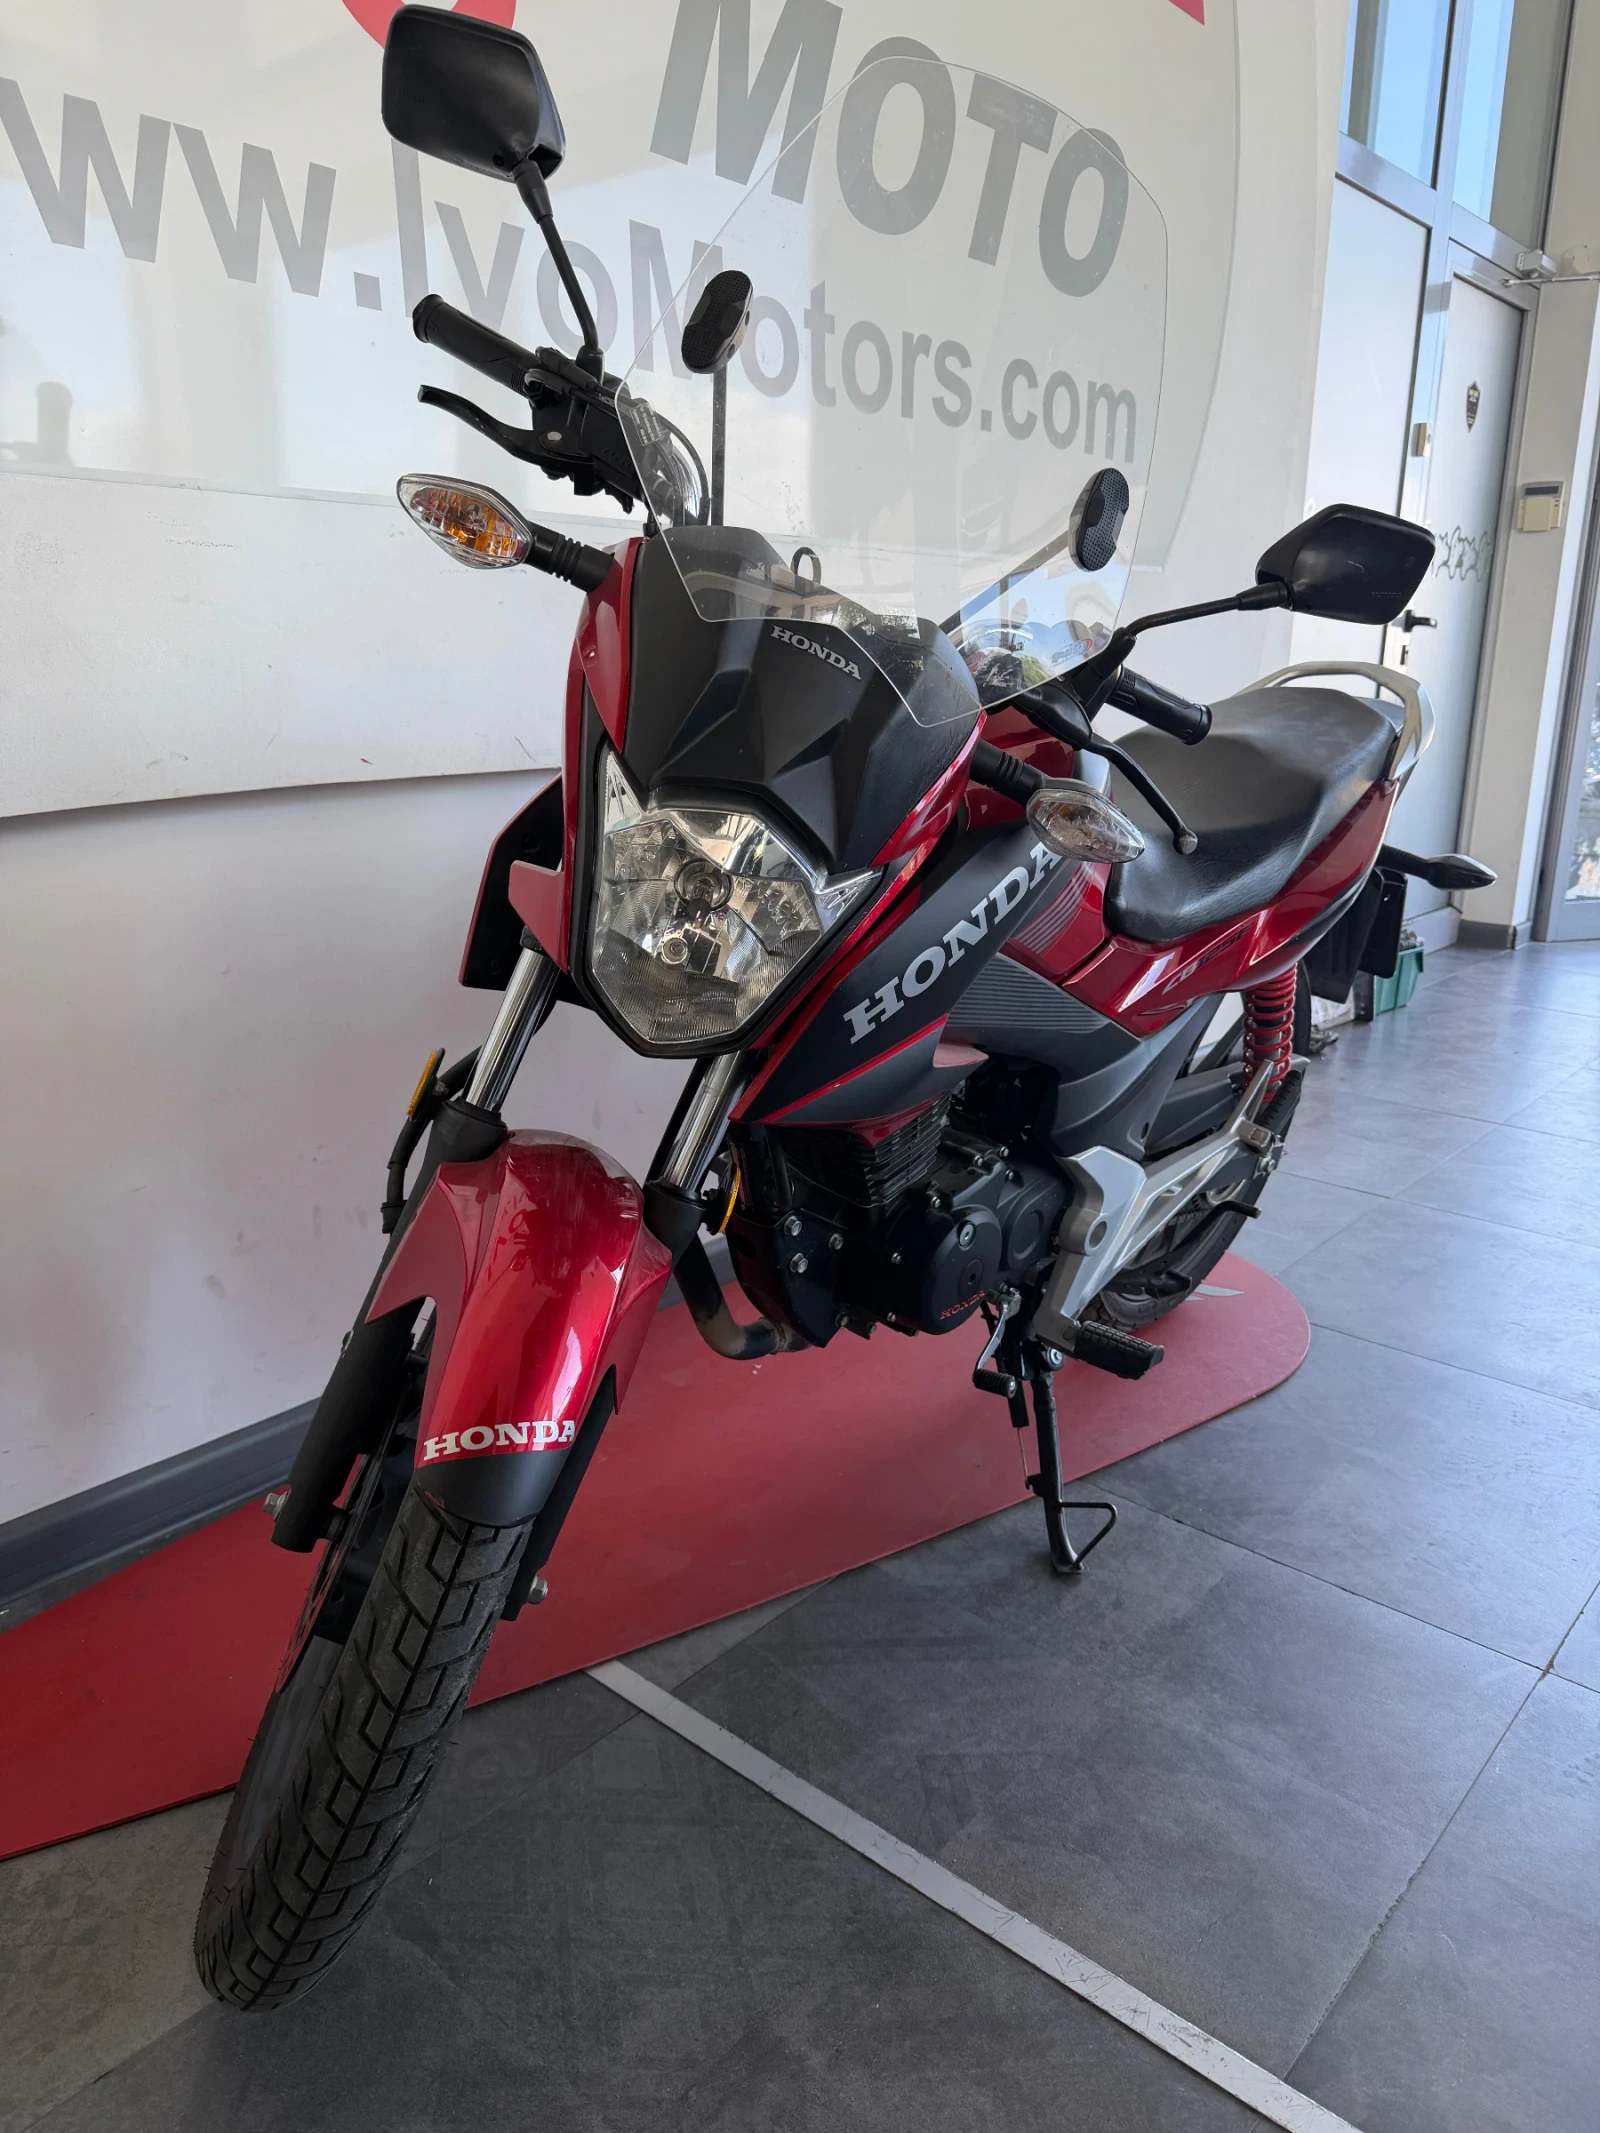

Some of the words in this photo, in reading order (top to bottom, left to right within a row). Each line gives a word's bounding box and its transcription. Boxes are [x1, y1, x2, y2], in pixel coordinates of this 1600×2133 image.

[649, 0, 1130, 298] MOTO
[770, 625, 862, 681] HONDA
[843, 841, 1063, 1045] HONDA
[940, 1290, 985, 1320] HONDA
[423, 1420, 575, 1461] HONDA
